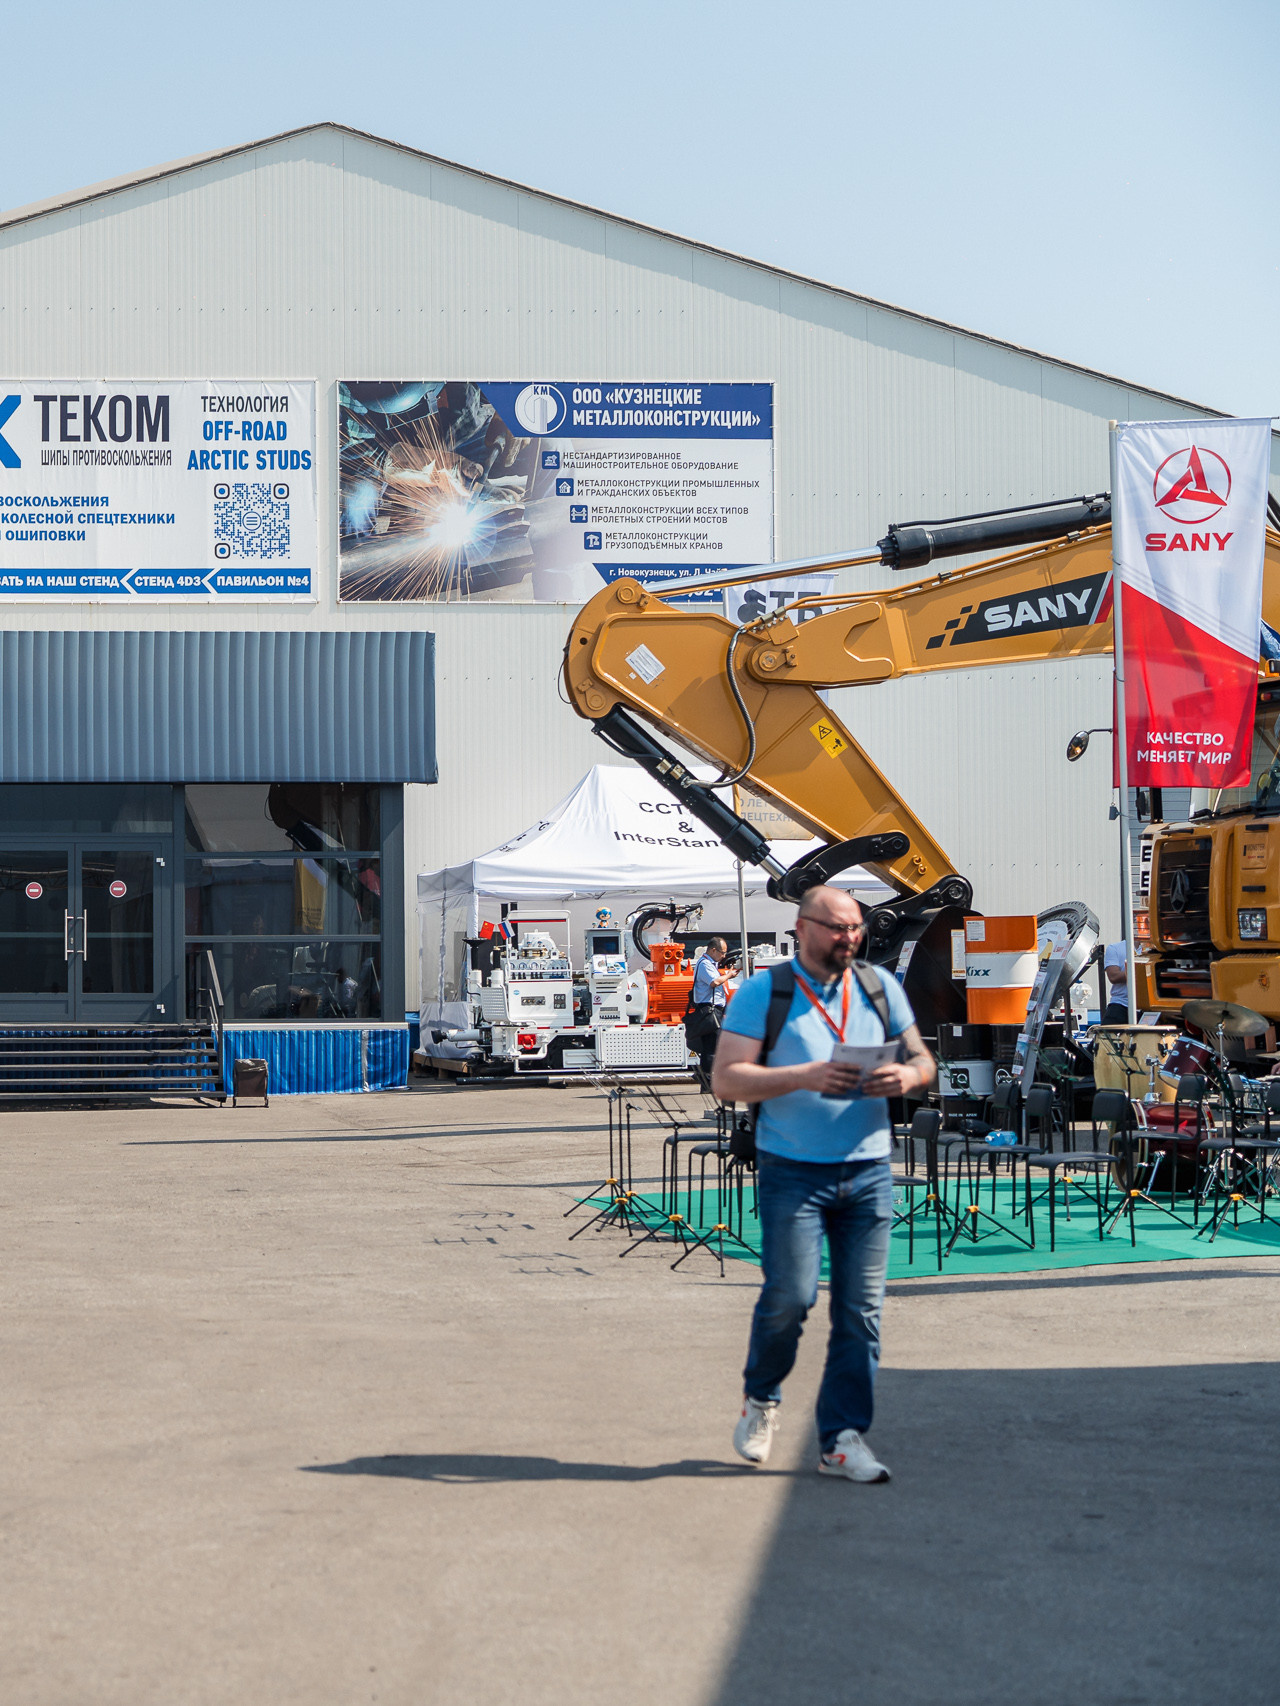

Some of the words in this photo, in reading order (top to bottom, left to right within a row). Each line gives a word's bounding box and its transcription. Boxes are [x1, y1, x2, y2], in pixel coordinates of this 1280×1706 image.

[200, 395, 289, 413] ТЕХНОЛОГИЯ
[572, 388, 602, 405] ООО
[605, 388, 702, 407] «КУЗНЕЦКИЕ
[34, 395, 170, 443] ТЕКОМ
[573, 410, 761, 429] МЕТАЛЛОКОНСТРУКЦИИ»
[202, 420, 287, 441] OFF-ROAD
[41, 450, 70, 467] ШИПЫ
[72, 449, 172, 467] ПРОТИВОСКОЛЬЖЕНИЯ
[187, 449, 249, 471] ARCTIC
[256, 449, 312, 470] STUDS
[563, 452, 681, 461] НЕСТАНДАРТИЗИРОВАННОЕ
[563, 461, 668, 470] МАШИНОСТРОИТЕЛЬНОЕ
[671, 461, 739, 471] ОБОРУДОВАНИЕ
[577, 479, 679, 489] МЕТАЛЛОКОНСТРУКЦИИ
[682, 479, 759, 488] ПРОМЫШЛЕННЫХ
[577, 488, 583, 497] И
[585, 488, 650, 498] ГРАЖДАНСКИХ
[652, 488, 697, 497] ОБЪЕКТОВ
[1, 509, 75, 524] КОЛЕСНОЙ
[78, 513, 175, 526] СПЕЦТЕХНИКИ
[591, 506, 693, 516] МЕТАЛЛОКОНСТРУКЦИИ
[696, 506, 718, 515] ВСЕХ
[720, 506, 749, 515] ТИПОВ
[591, 515, 643, 524] ПРОЛЕТНЫХ
[645, 514, 691, 524] СТРОЕНИЙ
[693, 515, 728, 524] МОСТОВ
[5, 529, 86, 541] ОШИПОВКИ
[605, 532, 708, 542] МЕТАЛЛОКОНСТРУКЦИИ
[1144, 532, 1234, 552] SANY
[689, 542, 723, 550] КРАНОВ
[618, 568, 677, 577] Новокузнецк,
[679, 569, 691, 577] ул.
[26, 574, 44, 587] НА
[46, 574, 77, 587] НАШ
[79, 574, 120, 589] СТЕНД
[134, 574, 173, 589] СТЕНД
[177, 574, 201, 587] 4D3
[217, 574, 284, 587] ПАВИЛЬОН
[287, 574, 310, 587] №4
[984, 588, 1093, 632] SANY
[1146, 732, 1224, 747] КАЧЕСТВО
[1137, 750, 1195, 763] МЕНЯЕТ
[1197, 750, 1232, 765] МИР
[678, 822, 695, 833] &
